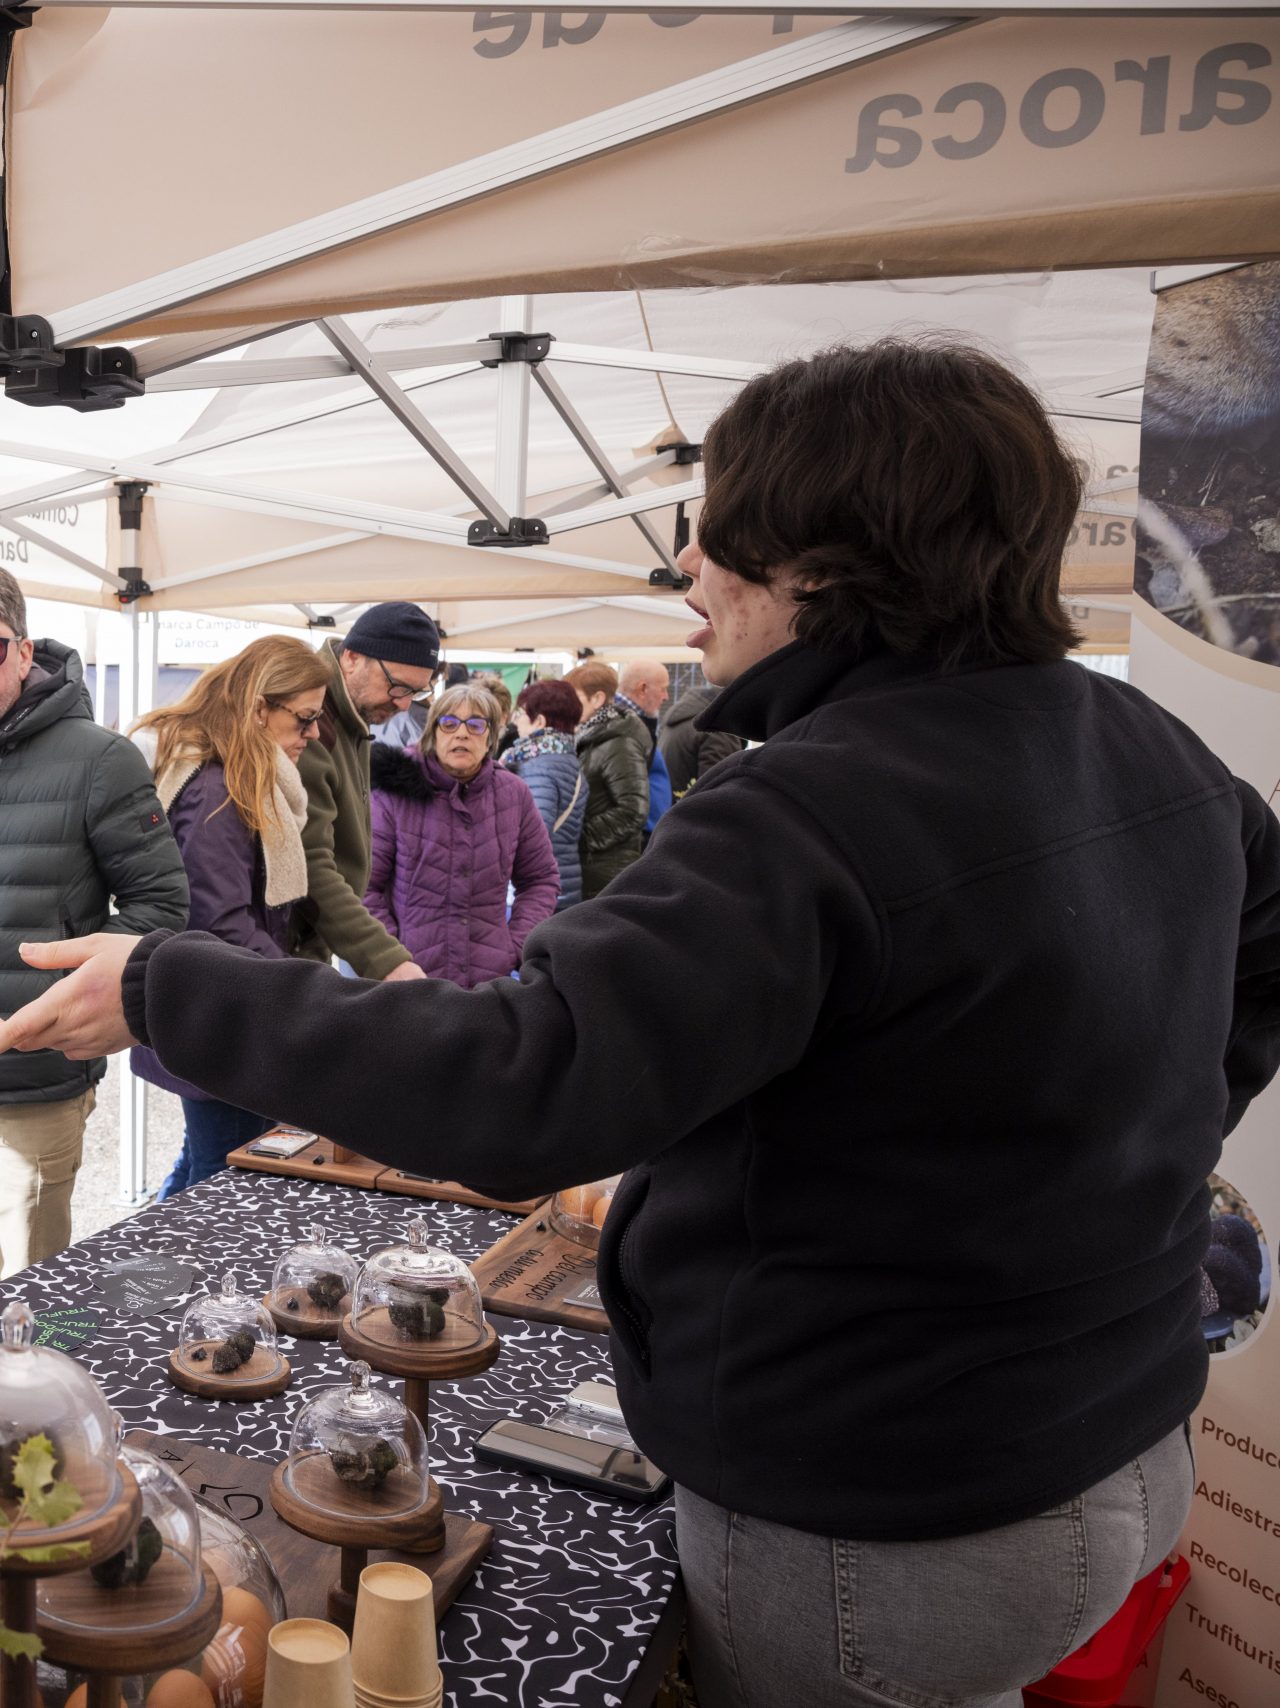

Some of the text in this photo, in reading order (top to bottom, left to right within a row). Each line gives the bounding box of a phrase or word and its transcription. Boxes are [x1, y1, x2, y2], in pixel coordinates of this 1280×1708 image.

[196, 618, 241, 631] Campo
[175, 636, 219, 649] Daroca
[524, 1270, 568, 1301] campo
[1201, 1416, 1280, 1470] Produc
